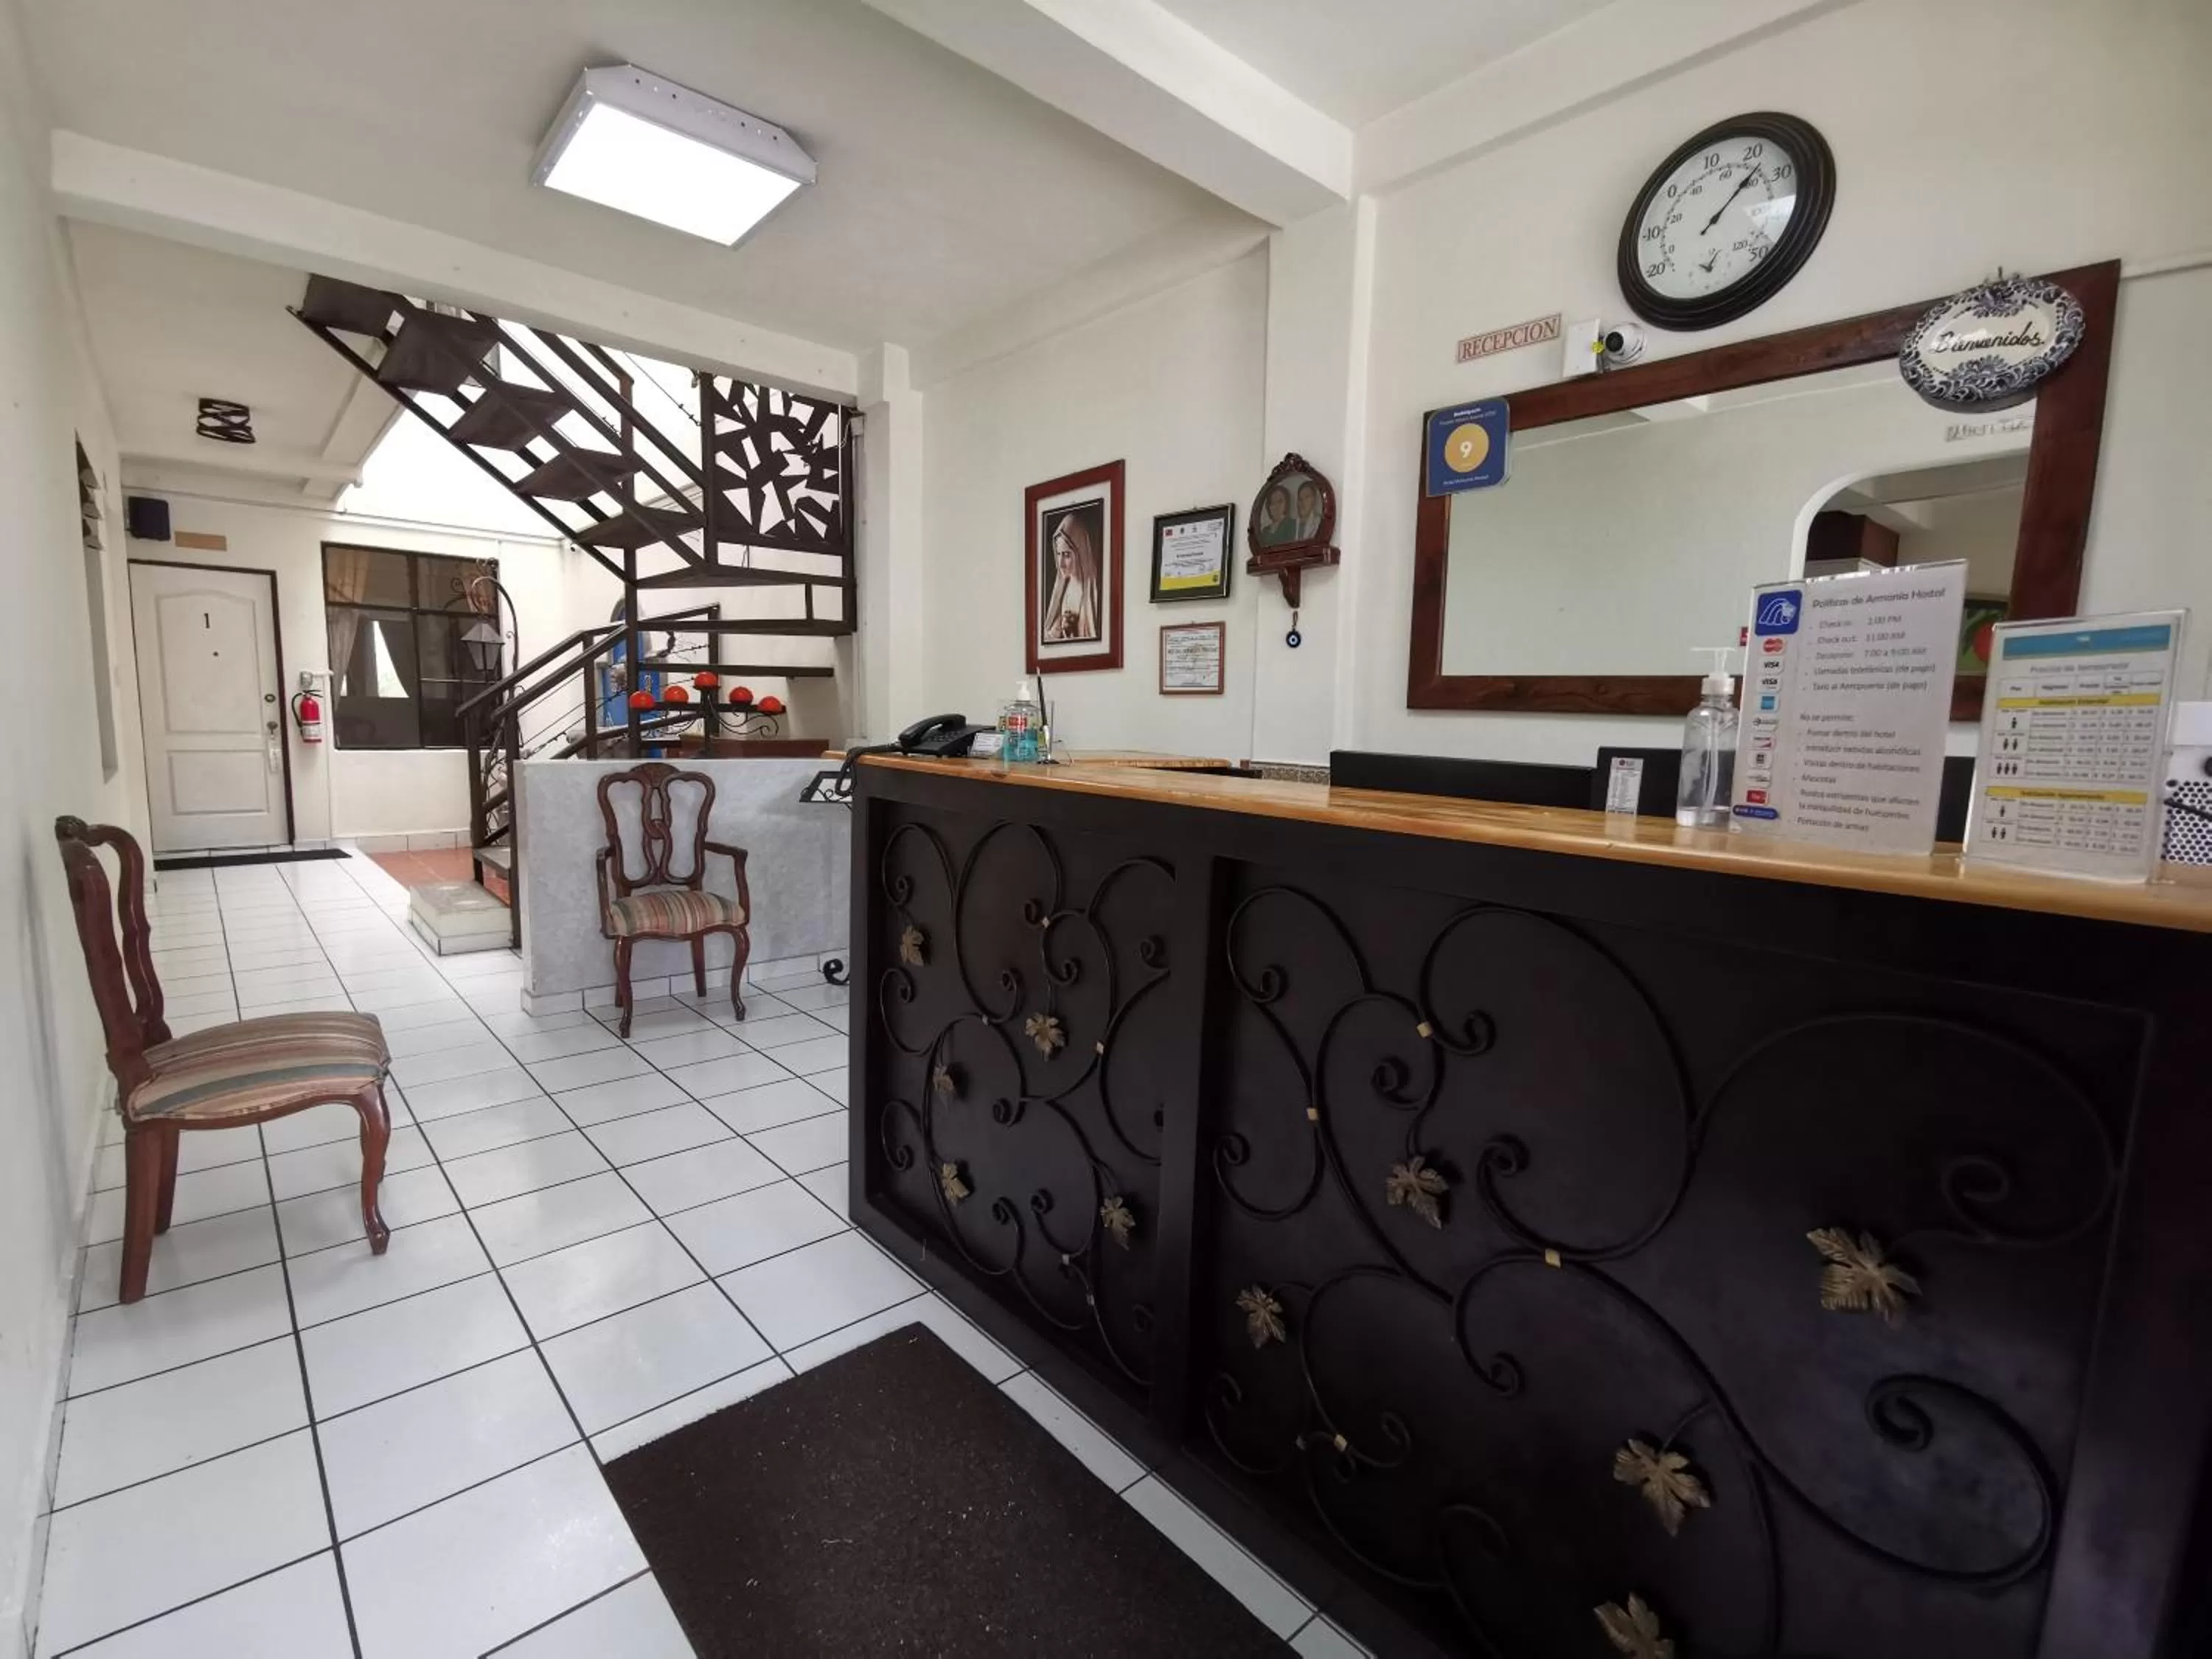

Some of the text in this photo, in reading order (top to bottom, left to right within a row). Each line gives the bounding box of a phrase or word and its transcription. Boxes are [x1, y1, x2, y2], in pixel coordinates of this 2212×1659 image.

[1743, 142, 1763, 161] 20
[1704, 153, 1720, 170] 10
[1771, 164, 1792, 182] 30
[1667, 184, 1677, 198] 0
[1642, 225, 1660, 241] -10
[1749, 246, 1769, 262] 50
[1646, 262, 1666, 278] -20
[1463, 319, 1557, 359] RECEPCION
[1461, 441, 1472, 458] 9
[204, 613, 211, 629] 1
